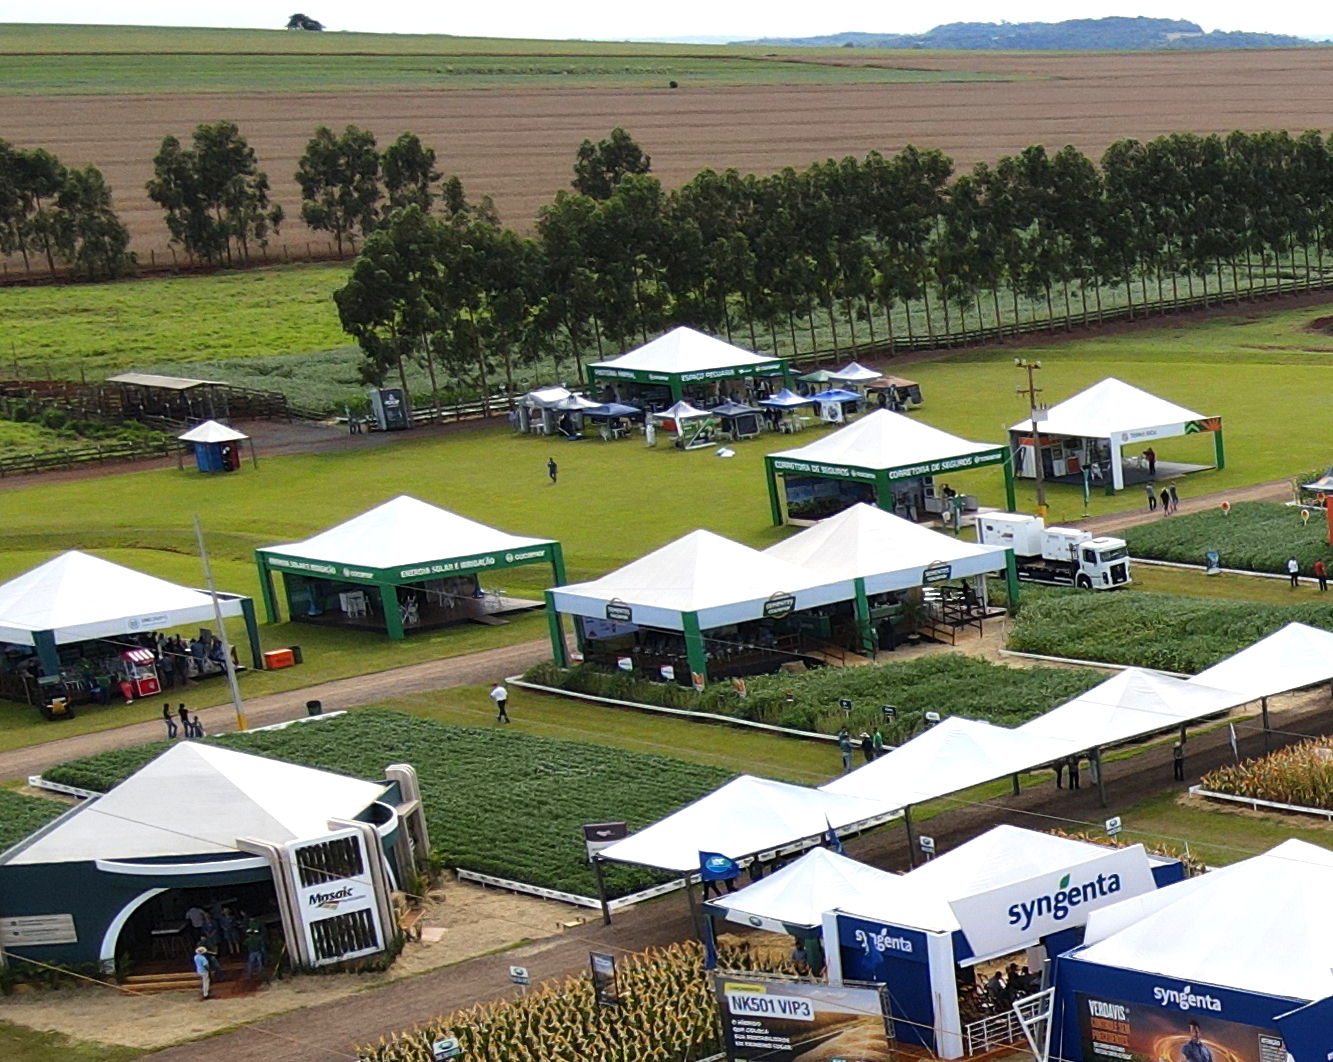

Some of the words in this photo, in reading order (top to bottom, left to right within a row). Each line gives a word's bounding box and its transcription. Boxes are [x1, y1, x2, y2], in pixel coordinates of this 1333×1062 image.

[309, 886, 354, 905] Mosaic
[1007, 871, 1121, 931] syngenta
[732, 995, 775, 1014] NK501
[778, 999, 811, 1017] VIP3
[1153, 986, 1222, 1012] syngenta
